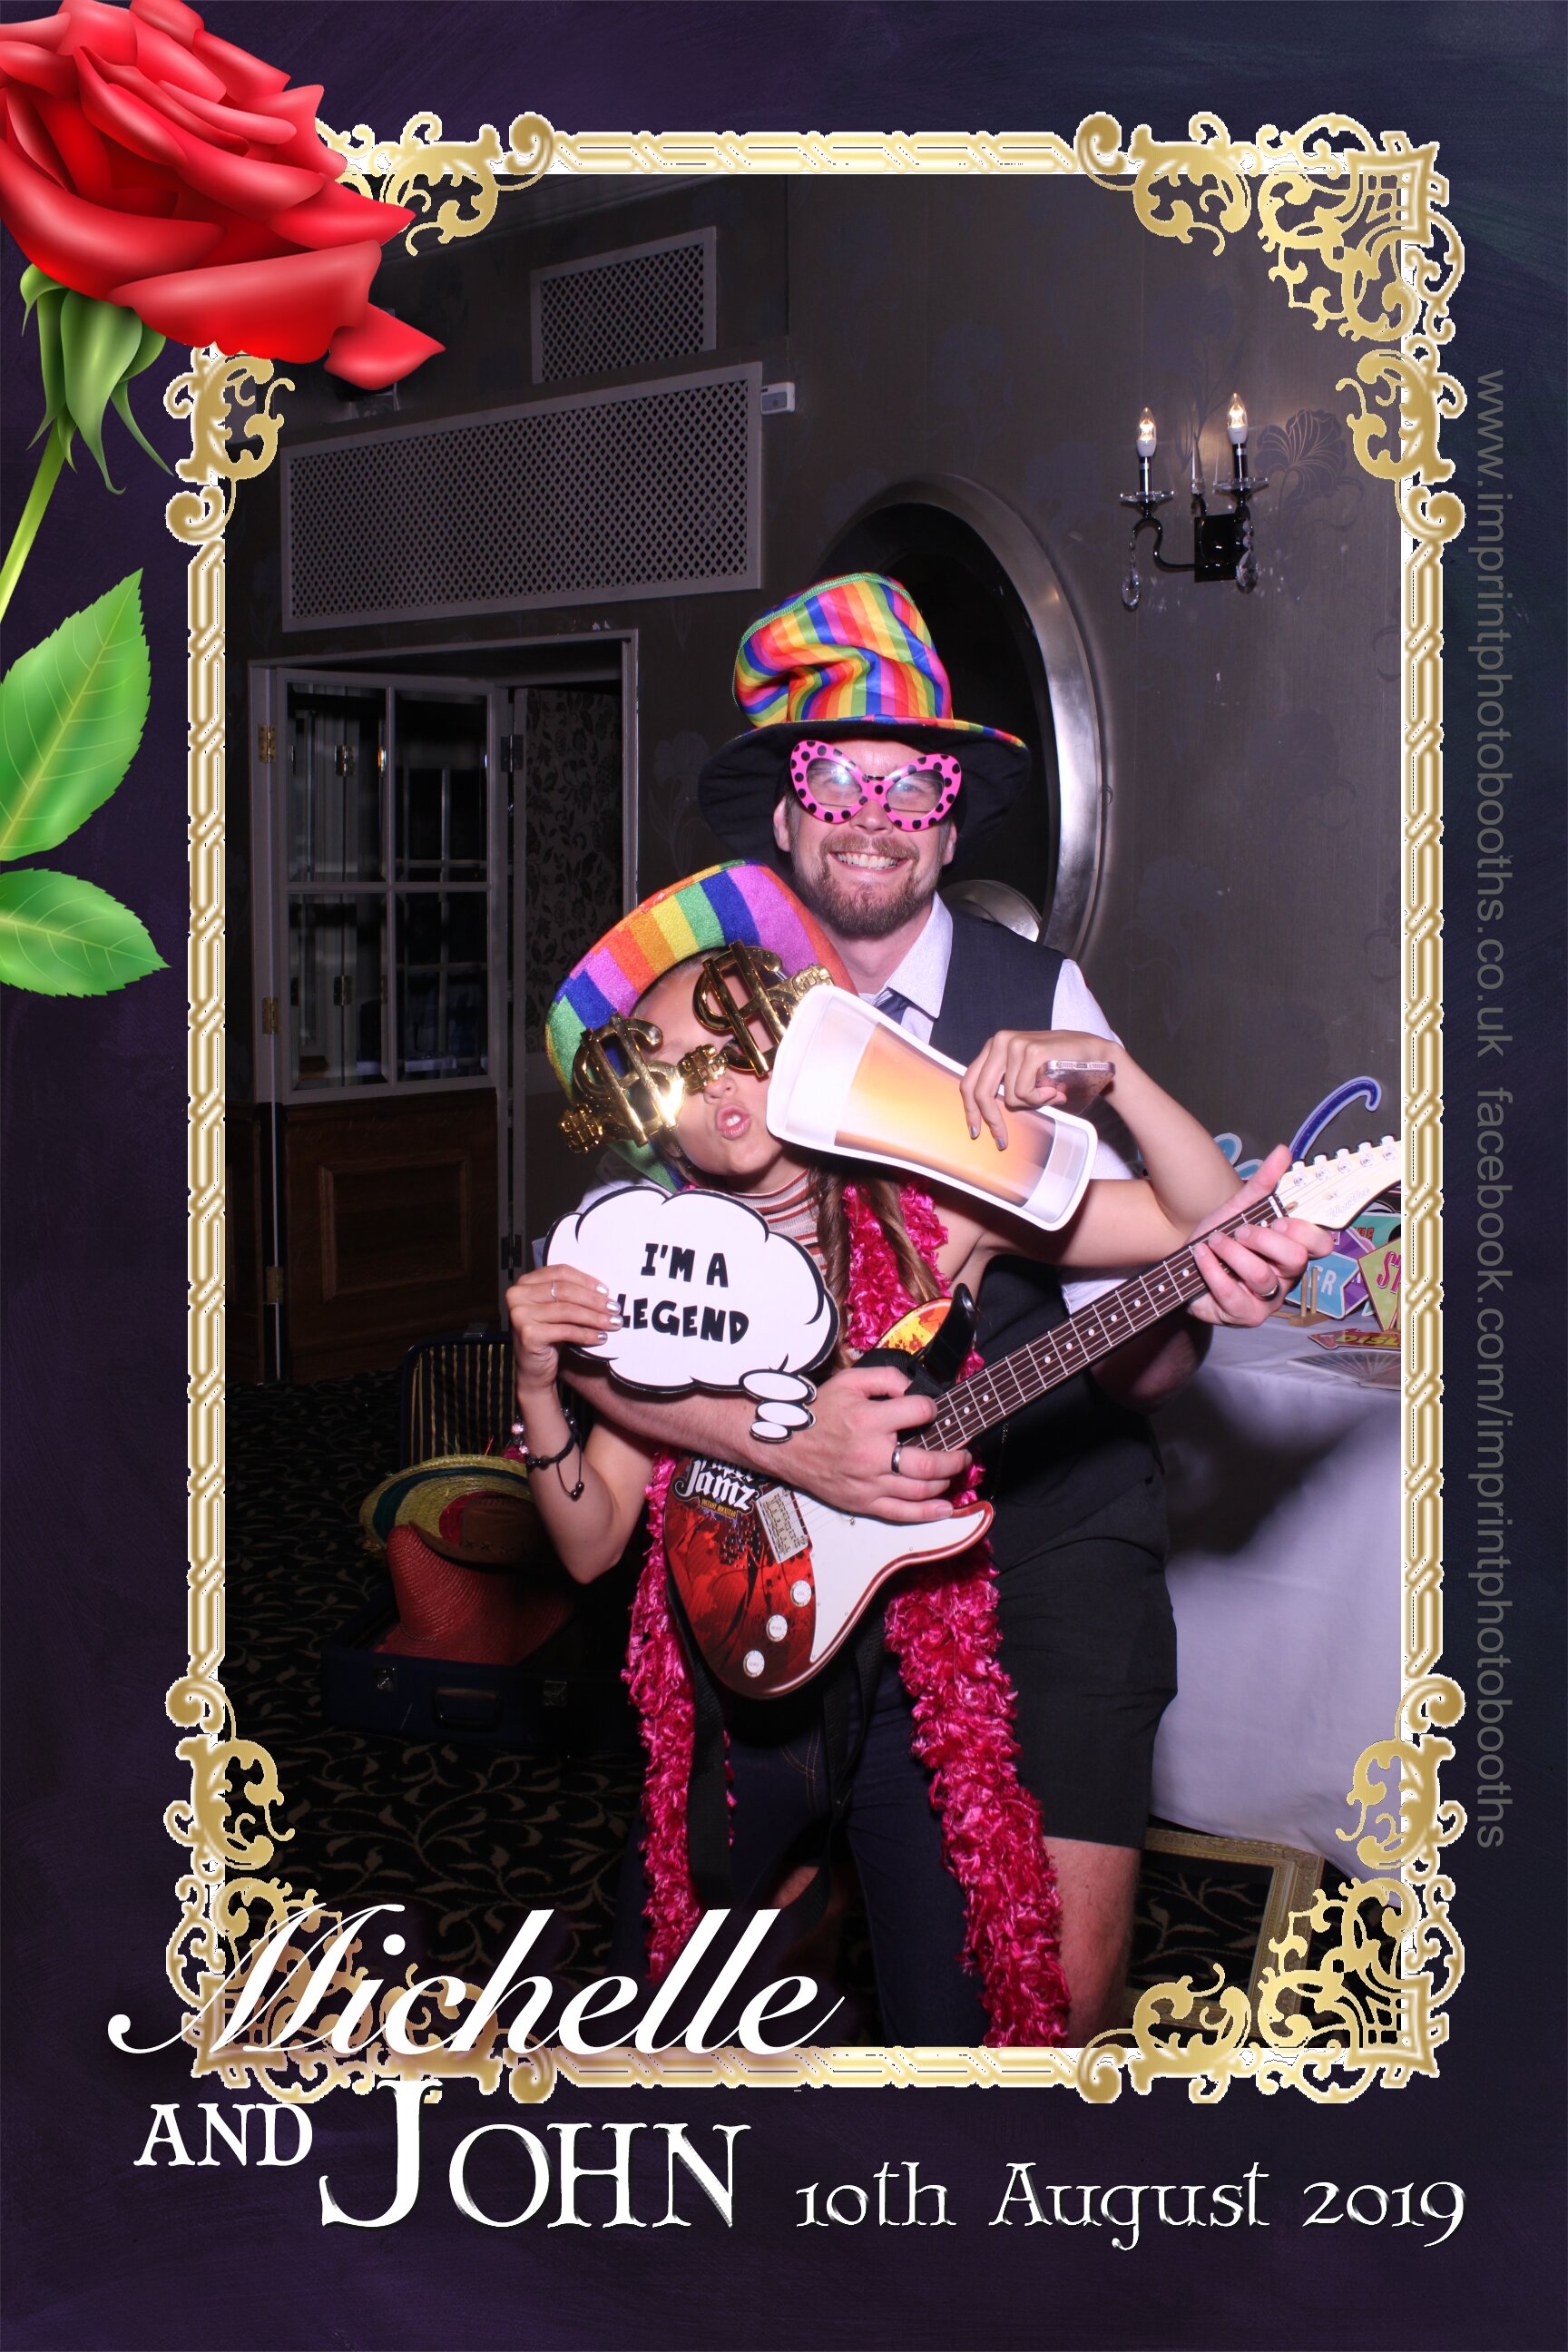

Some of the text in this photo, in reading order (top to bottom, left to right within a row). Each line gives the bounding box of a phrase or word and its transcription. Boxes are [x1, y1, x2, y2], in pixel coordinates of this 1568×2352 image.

[641, 1242, 729, 1288] I'M A
[617, 1293, 750, 1345] LEGEND
[675, 1459, 760, 1512] Jamz
